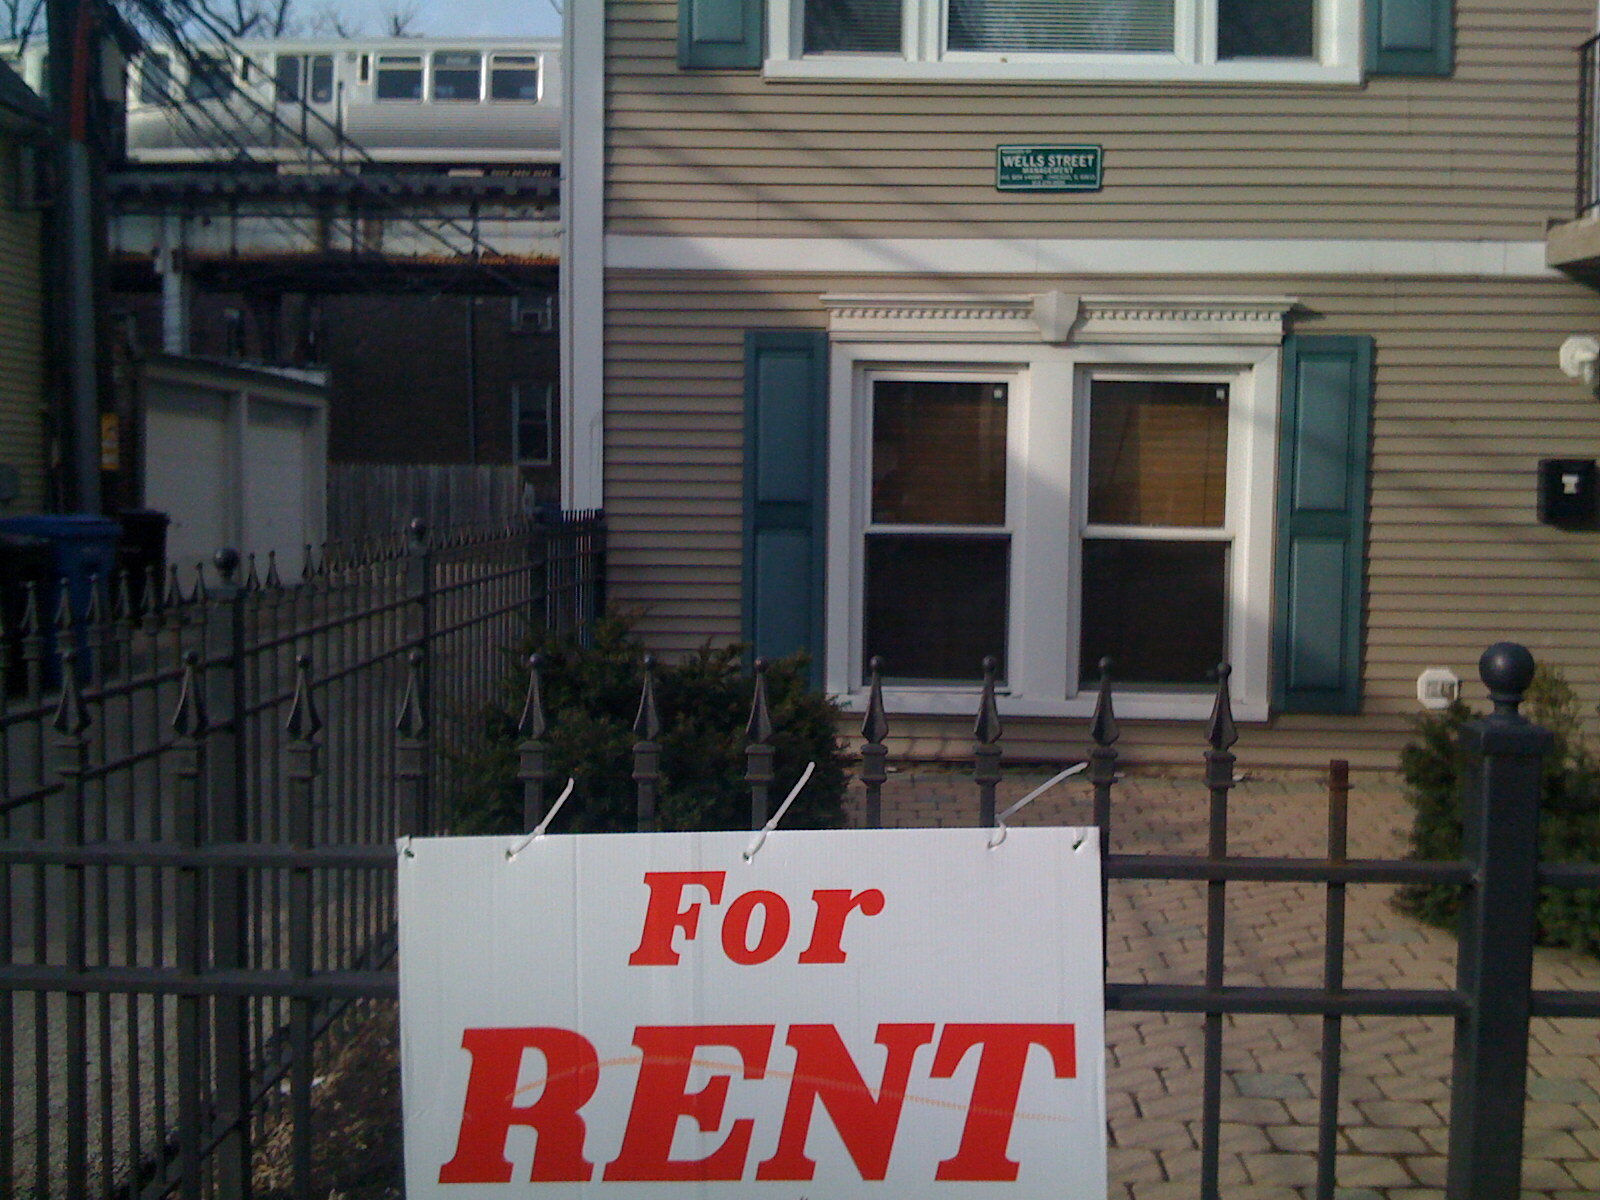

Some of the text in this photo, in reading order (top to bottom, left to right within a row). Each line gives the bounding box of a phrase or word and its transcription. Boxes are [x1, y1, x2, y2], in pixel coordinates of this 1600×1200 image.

[1002, 155, 1095, 167] WELLS STREET
[629, 871, 885, 966] For
[440, 1023, 1076, 1183] RENT
